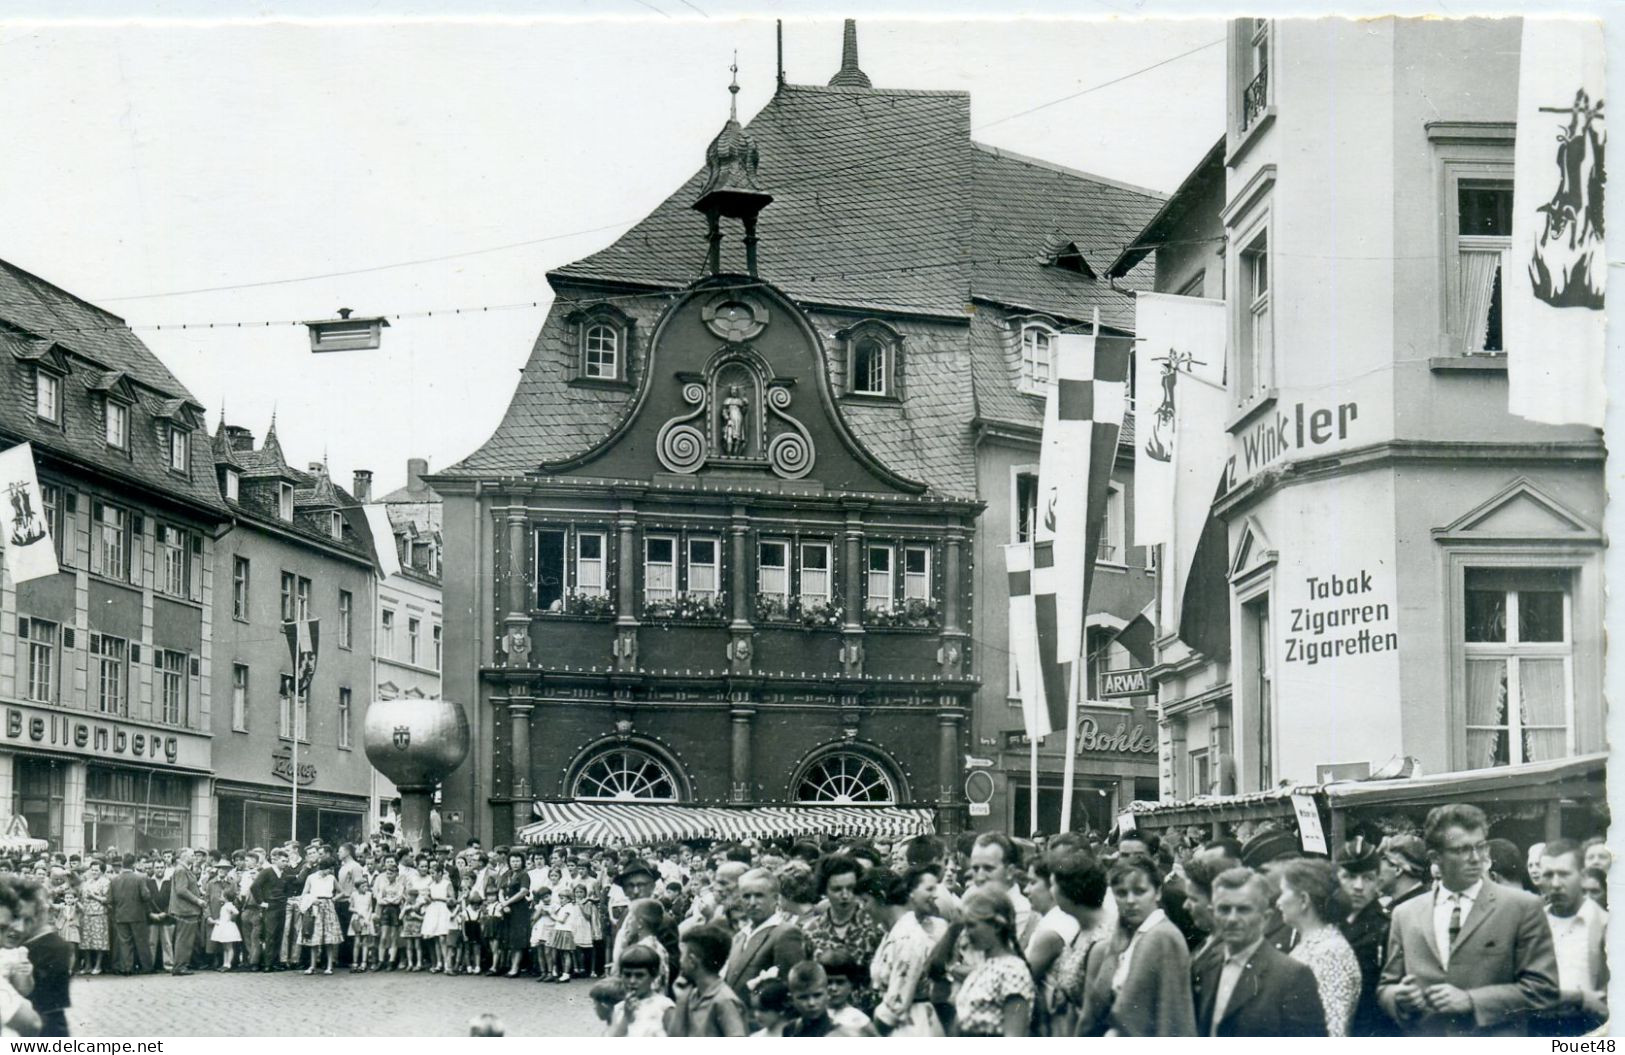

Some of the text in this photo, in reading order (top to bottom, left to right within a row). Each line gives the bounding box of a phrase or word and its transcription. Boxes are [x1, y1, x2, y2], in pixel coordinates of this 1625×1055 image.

[1242, 401, 1358, 474] Winkler
[1306, 570, 1373, 600] Tabak
[1290, 603, 1389, 635] Zigarren
[1284, 629, 1398, 664] Zigaretten
[1105, 671, 1145, 693] ARWA
[6, 707, 178, 763] Bellenberg
